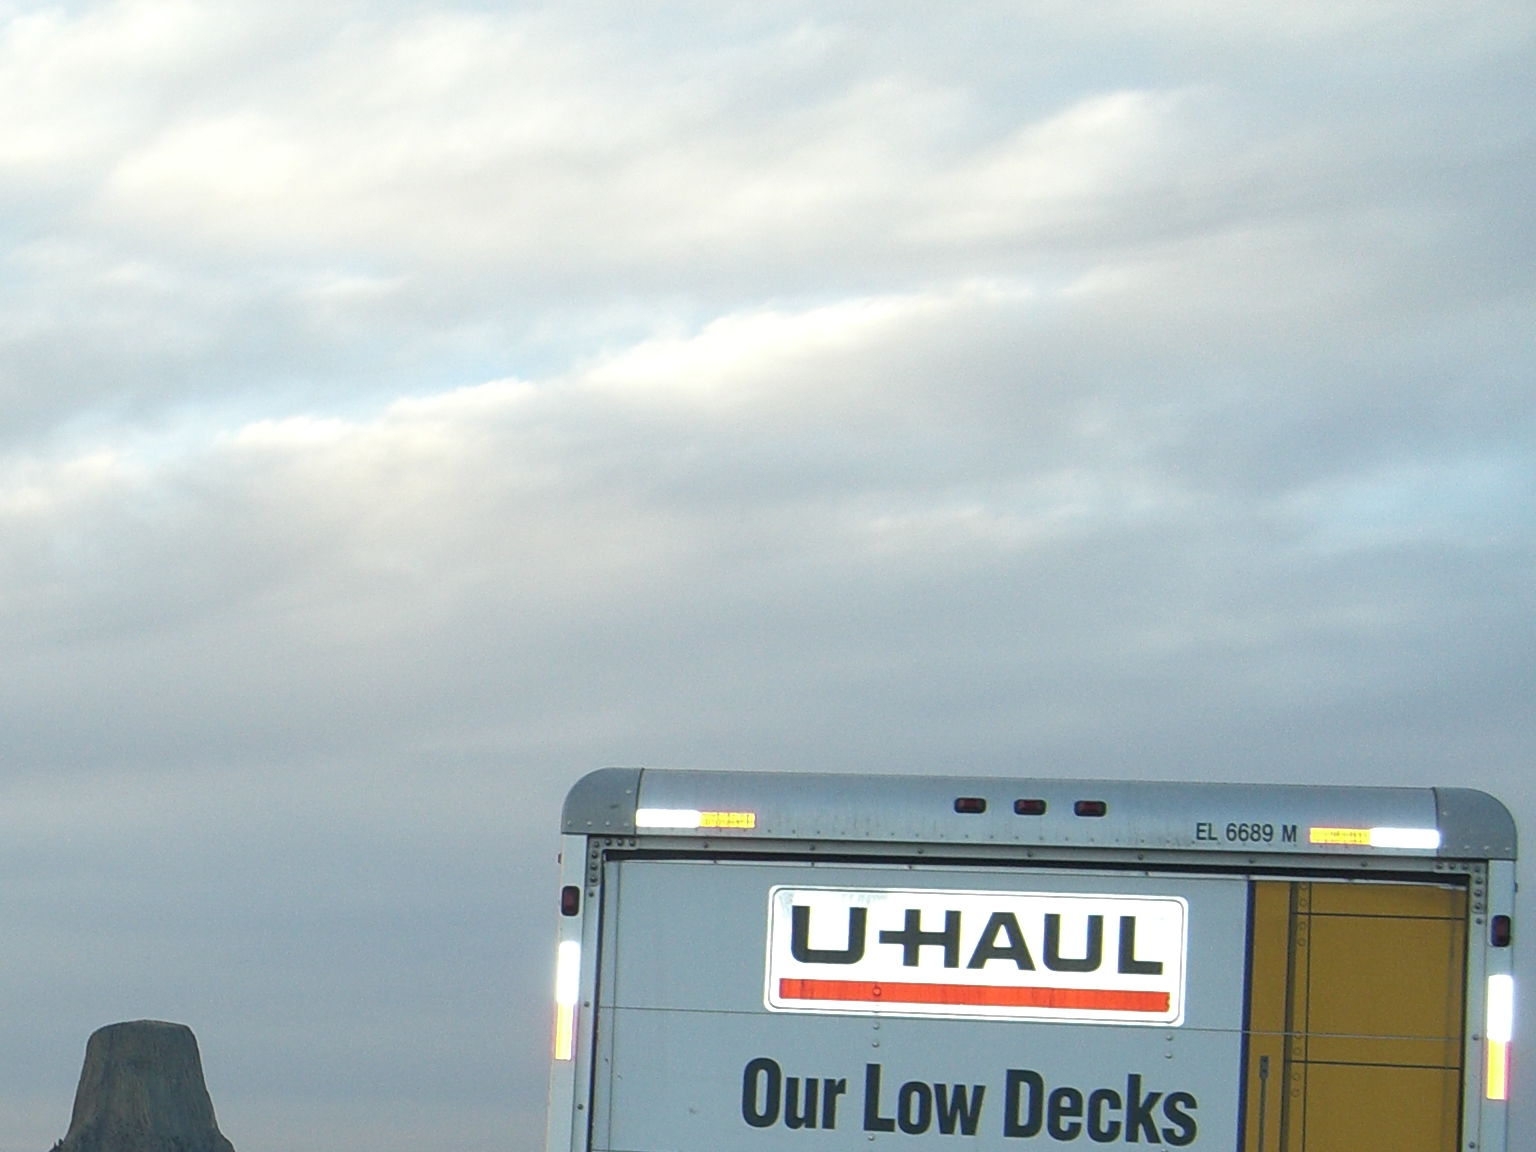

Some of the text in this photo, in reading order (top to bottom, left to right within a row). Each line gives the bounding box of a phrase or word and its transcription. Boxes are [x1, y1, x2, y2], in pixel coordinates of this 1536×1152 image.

[1195, 822, 1218, 841] EL
[1225, 822, 1274, 843] 6689
[1281, 824, 1298, 843] M
[789, 904, 1164, 976] U-HAUL
[741, 1056, 1199, 1147] Our Low Decks
